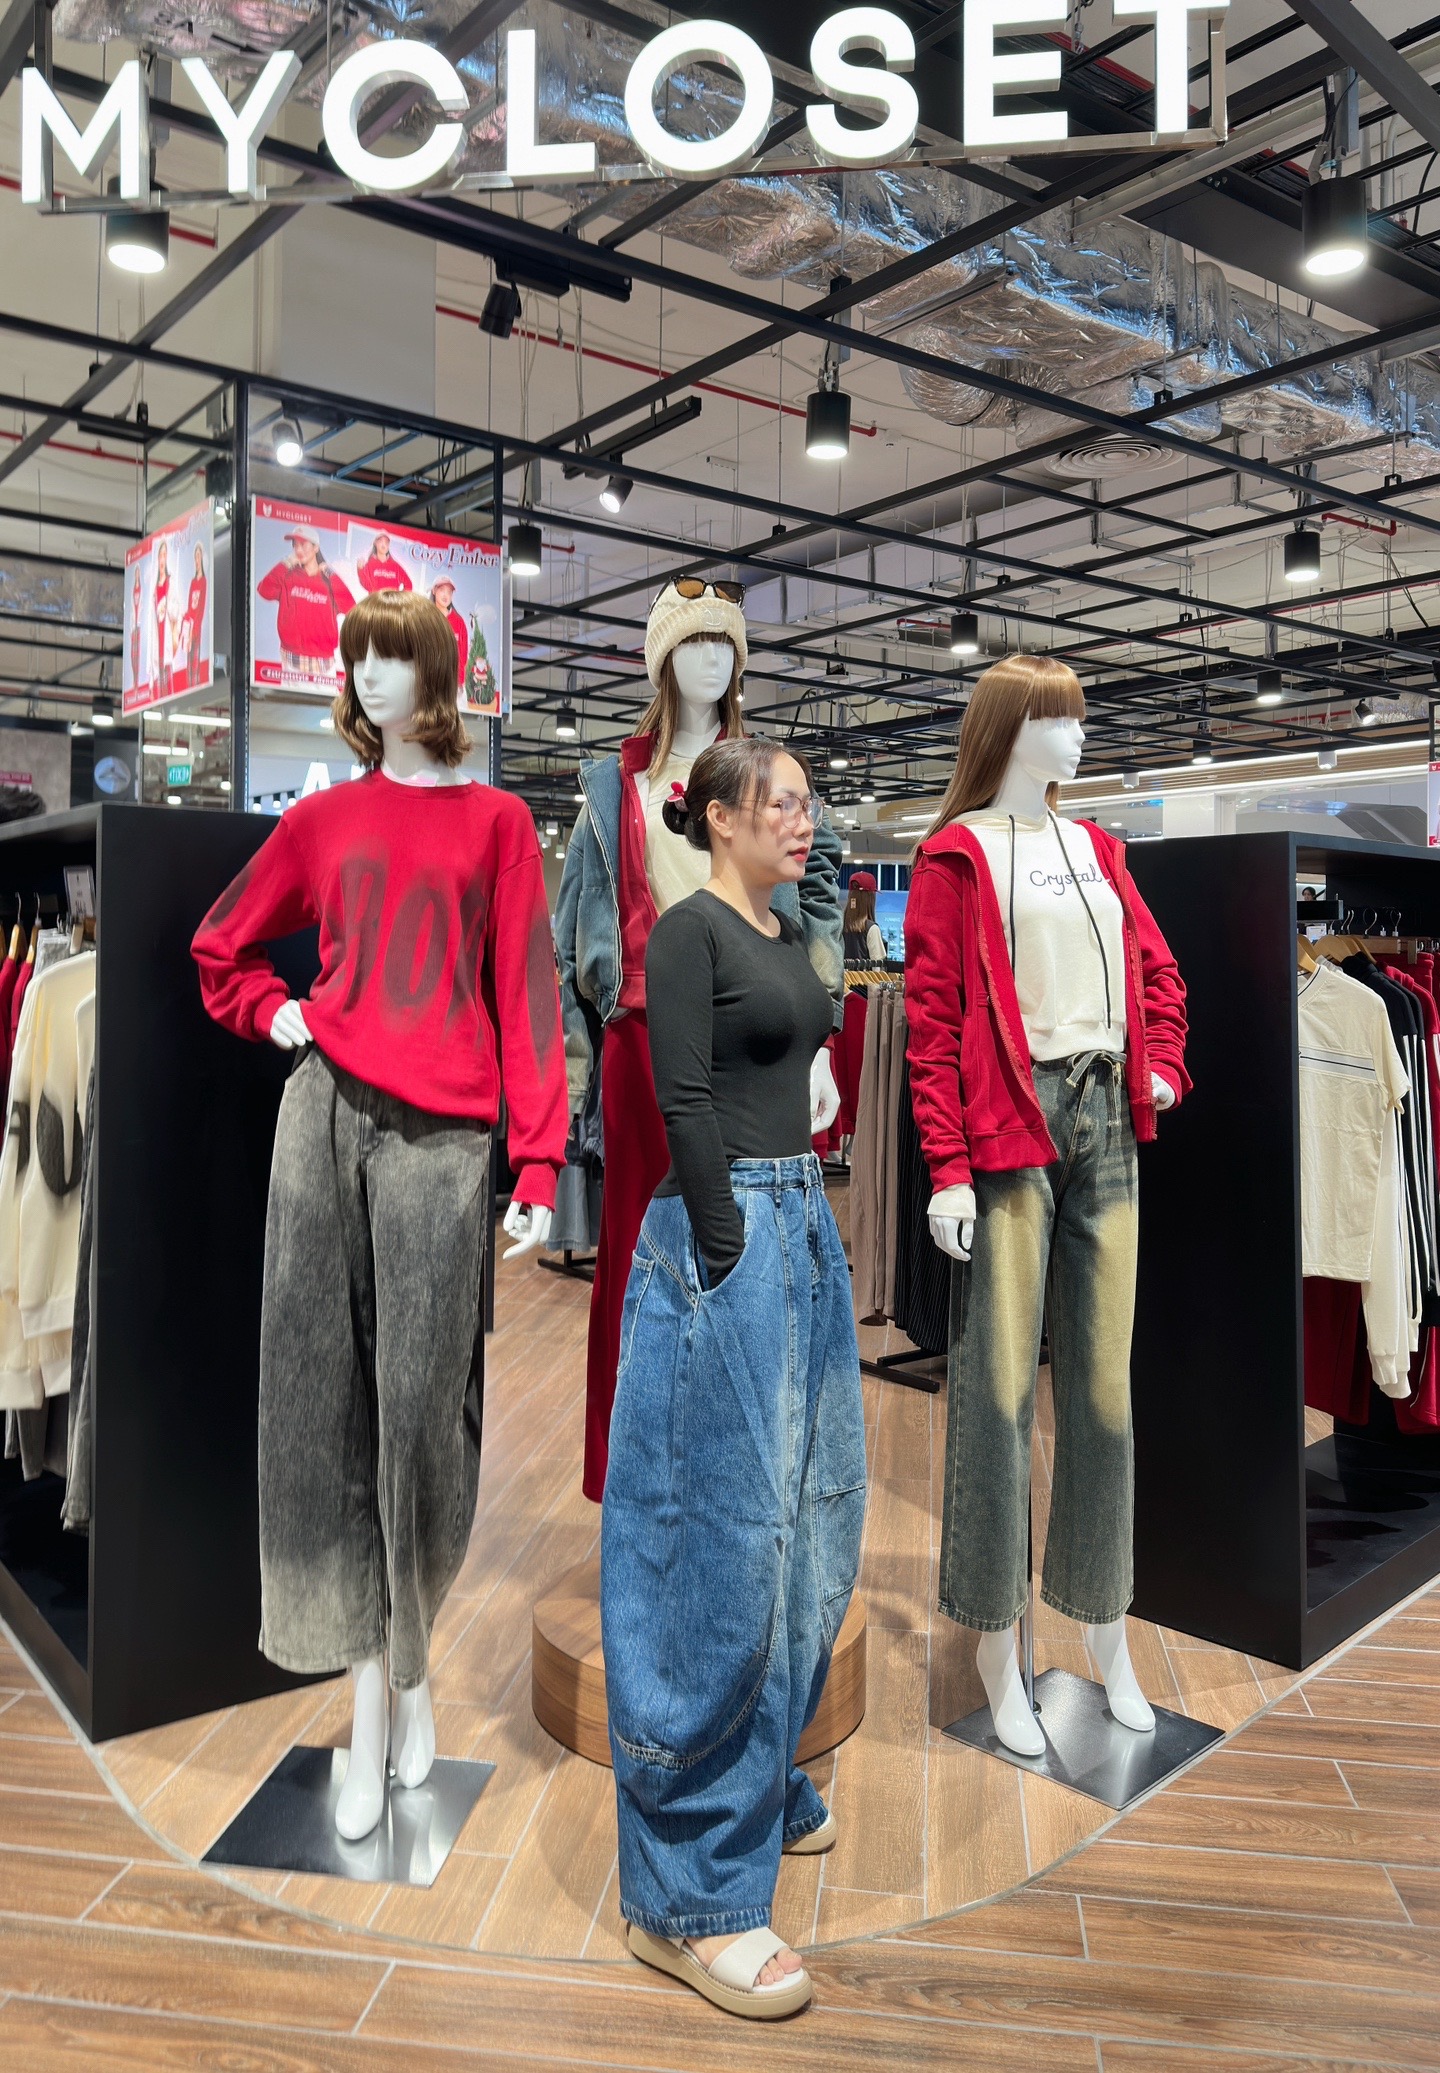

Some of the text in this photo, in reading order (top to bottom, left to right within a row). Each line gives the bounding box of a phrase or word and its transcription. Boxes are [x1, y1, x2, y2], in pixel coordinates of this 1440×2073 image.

[21, 0, 1230, 203] MYCLOSET
[410, 544, 499, 569] Cozy Ember
[1029, 863, 1103, 896] Crystal
